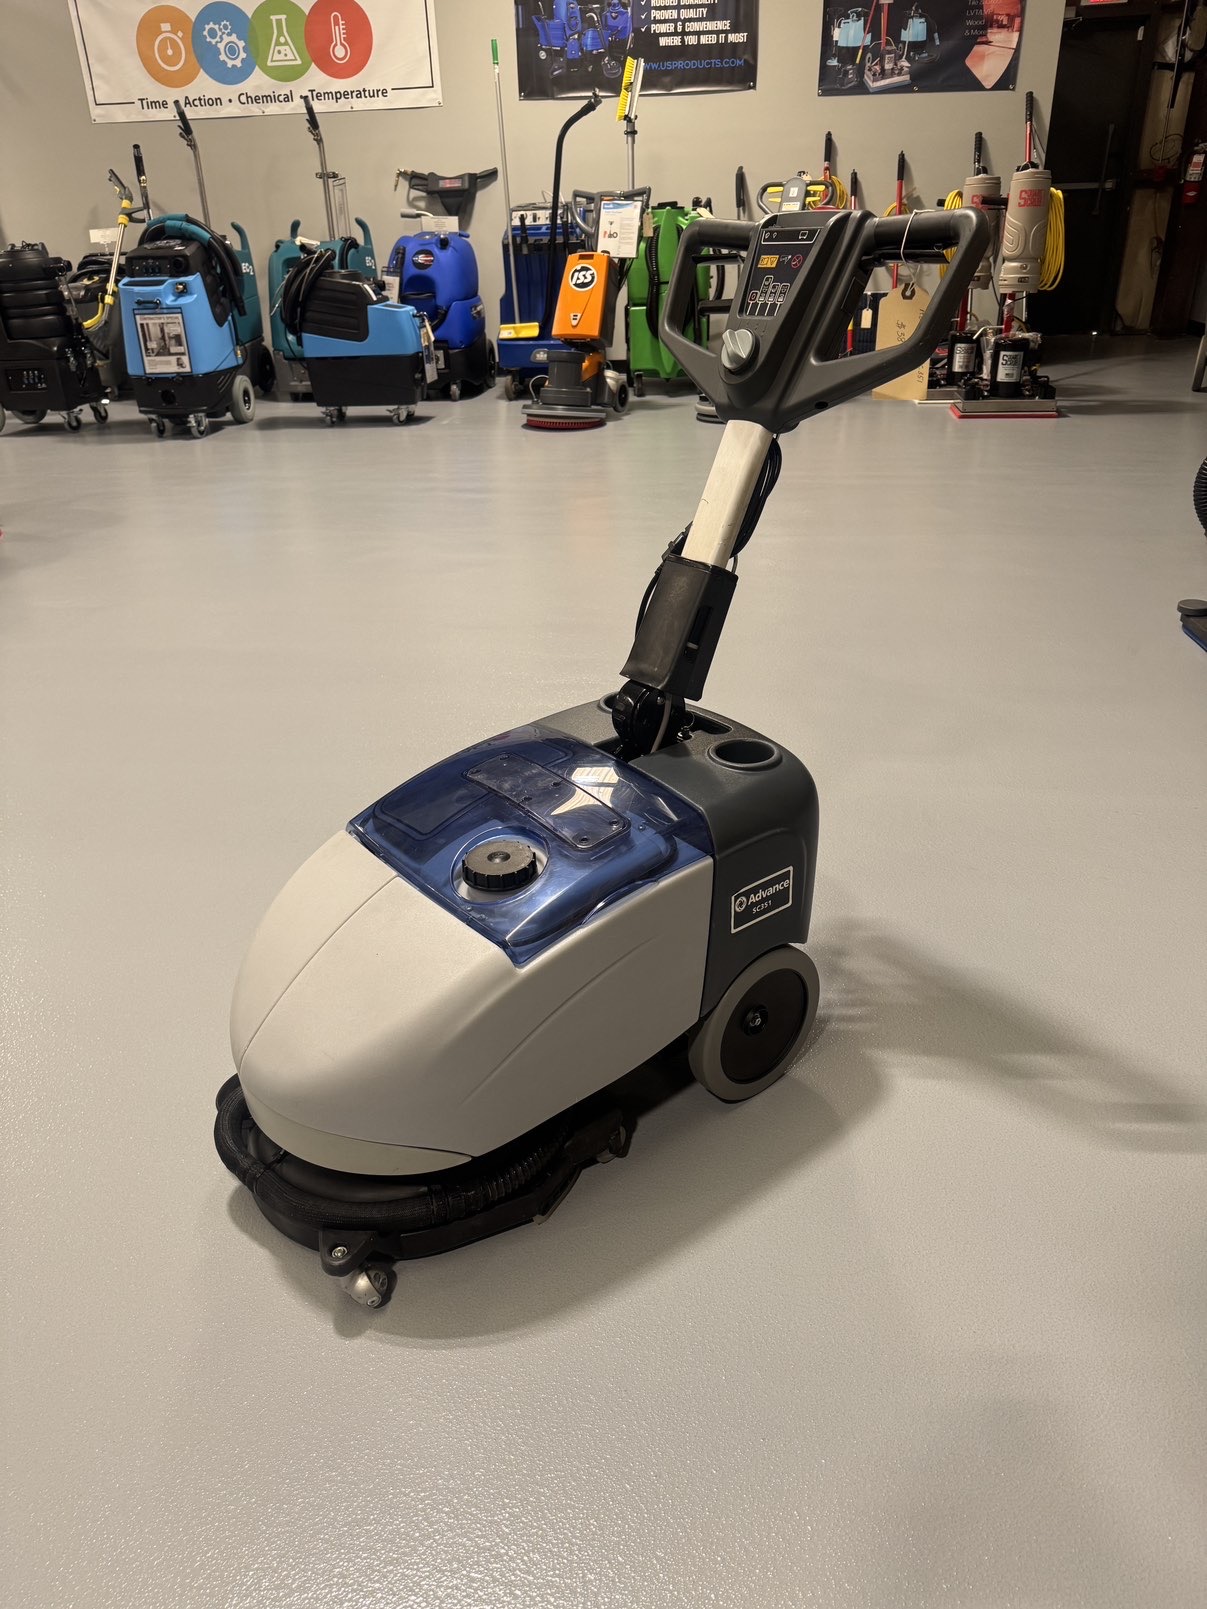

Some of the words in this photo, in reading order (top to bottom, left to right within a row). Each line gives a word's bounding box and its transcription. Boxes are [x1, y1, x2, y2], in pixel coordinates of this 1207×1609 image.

[651, 9, 678, 20] PROVEN
[680, 8, 708, 19] QUALITY
[651, 23, 675, 34] POWER
[677, 21, 683, 32] &
[685, 20, 731, 32] CONVENIENCE
[659, 36, 682, 47] WHERE
[684, 35, 698, 45] YOU
[700, 34, 717, 45] NEED
[719, 33, 726, 44] IT
[727, 32, 748, 43] MOST
[643, 58, 744, 71] WW.USPRODUCTS.COM
[138, 97, 169, 110] Time
[184, 94, 223, 108] Action
[238, 90, 294, 105] Chemical
[308, 87, 389, 103] Temperature
[572, 270, 594, 284] ISS
[748, 879, 789, 905] Advance
[752, 900, 772, 914] SC351
